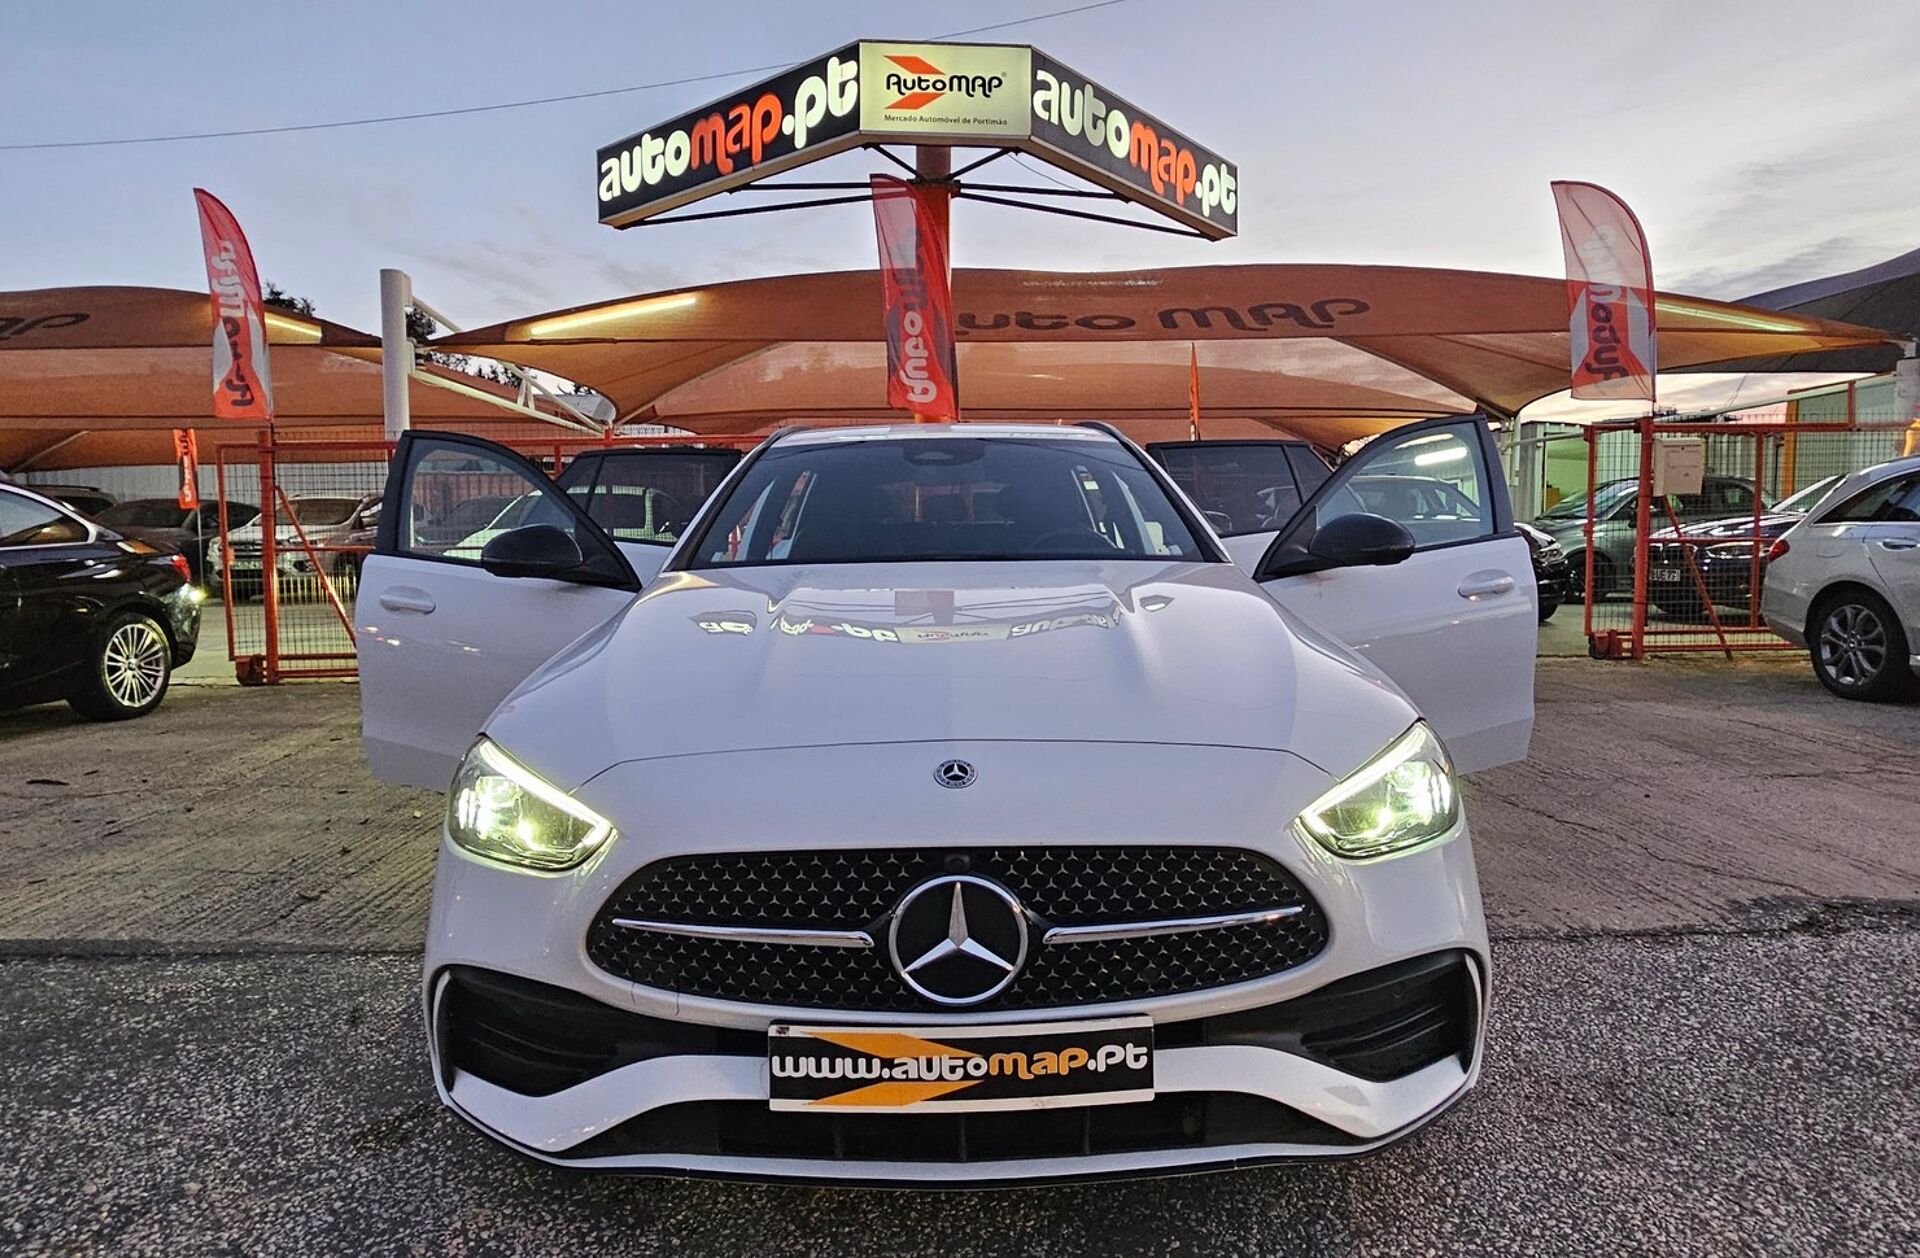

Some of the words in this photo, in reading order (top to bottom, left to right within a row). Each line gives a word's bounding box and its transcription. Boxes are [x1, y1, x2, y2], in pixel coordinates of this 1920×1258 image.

[599, 56, 858, 202] automap.pt
[884, 114, 917, 123] Mercado
[918, 115, 960, 124] Automóvel
[1033, 69, 1236, 217] automap.pt
[955, 311, 1136, 336] uto
[771, 1042, 1149, 1081] www.automap.pt
